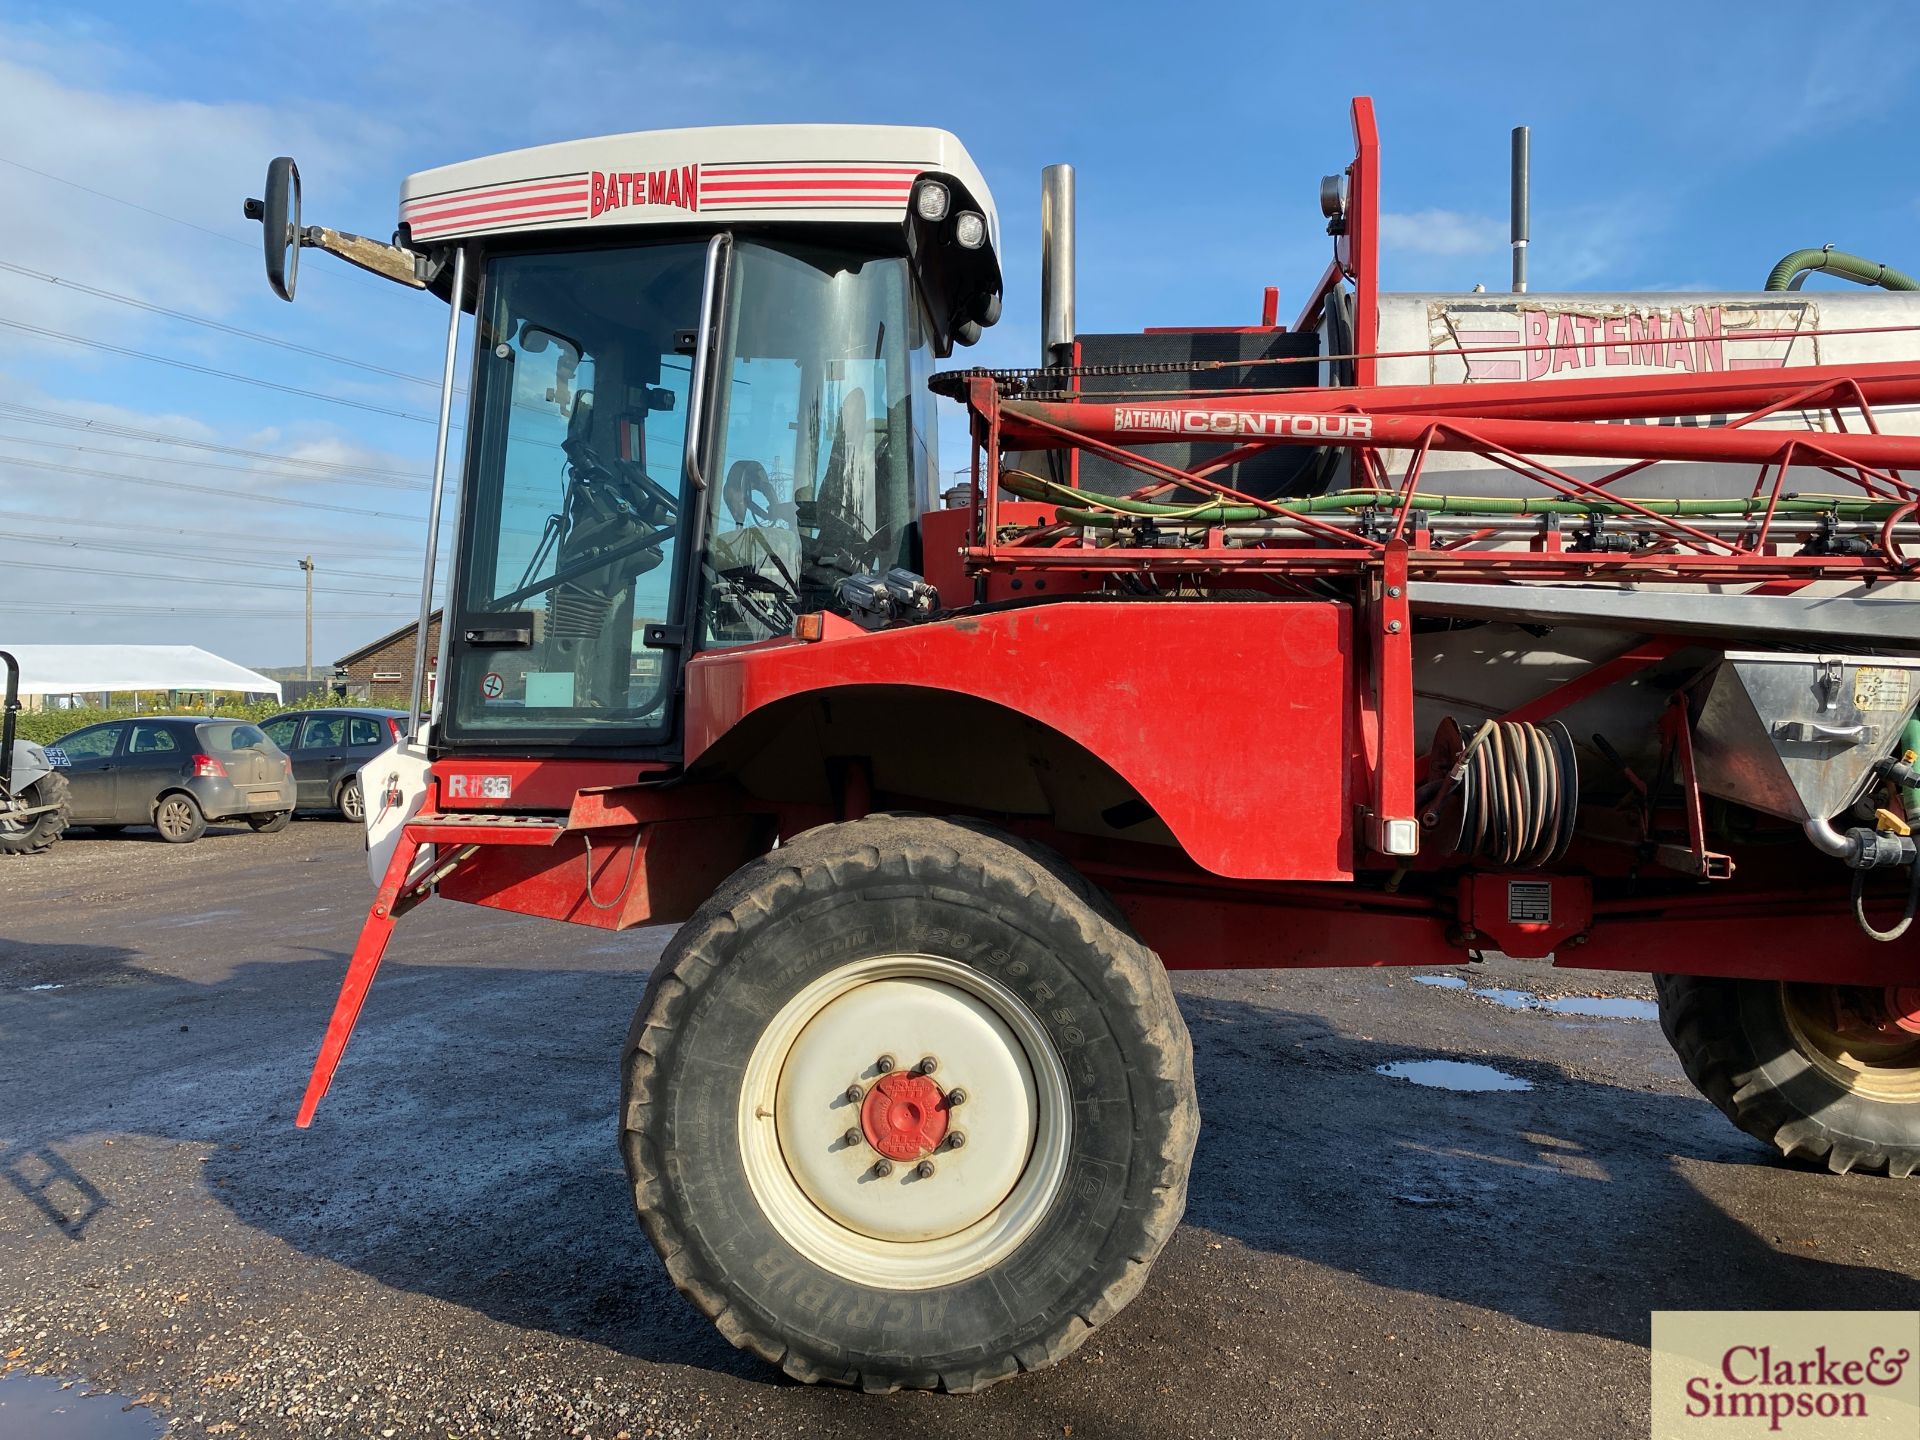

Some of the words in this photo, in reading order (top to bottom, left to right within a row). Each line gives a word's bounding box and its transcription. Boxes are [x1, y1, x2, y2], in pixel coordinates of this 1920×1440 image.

[591, 163, 698, 218] BATEMAN
[1525, 306, 1723, 381] BATEMAN
[1114, 408, 1182, 433] BATEMAN
[1184, 412, 1372, 437] CONTOUR
[50, 757, 69, 765] 572
